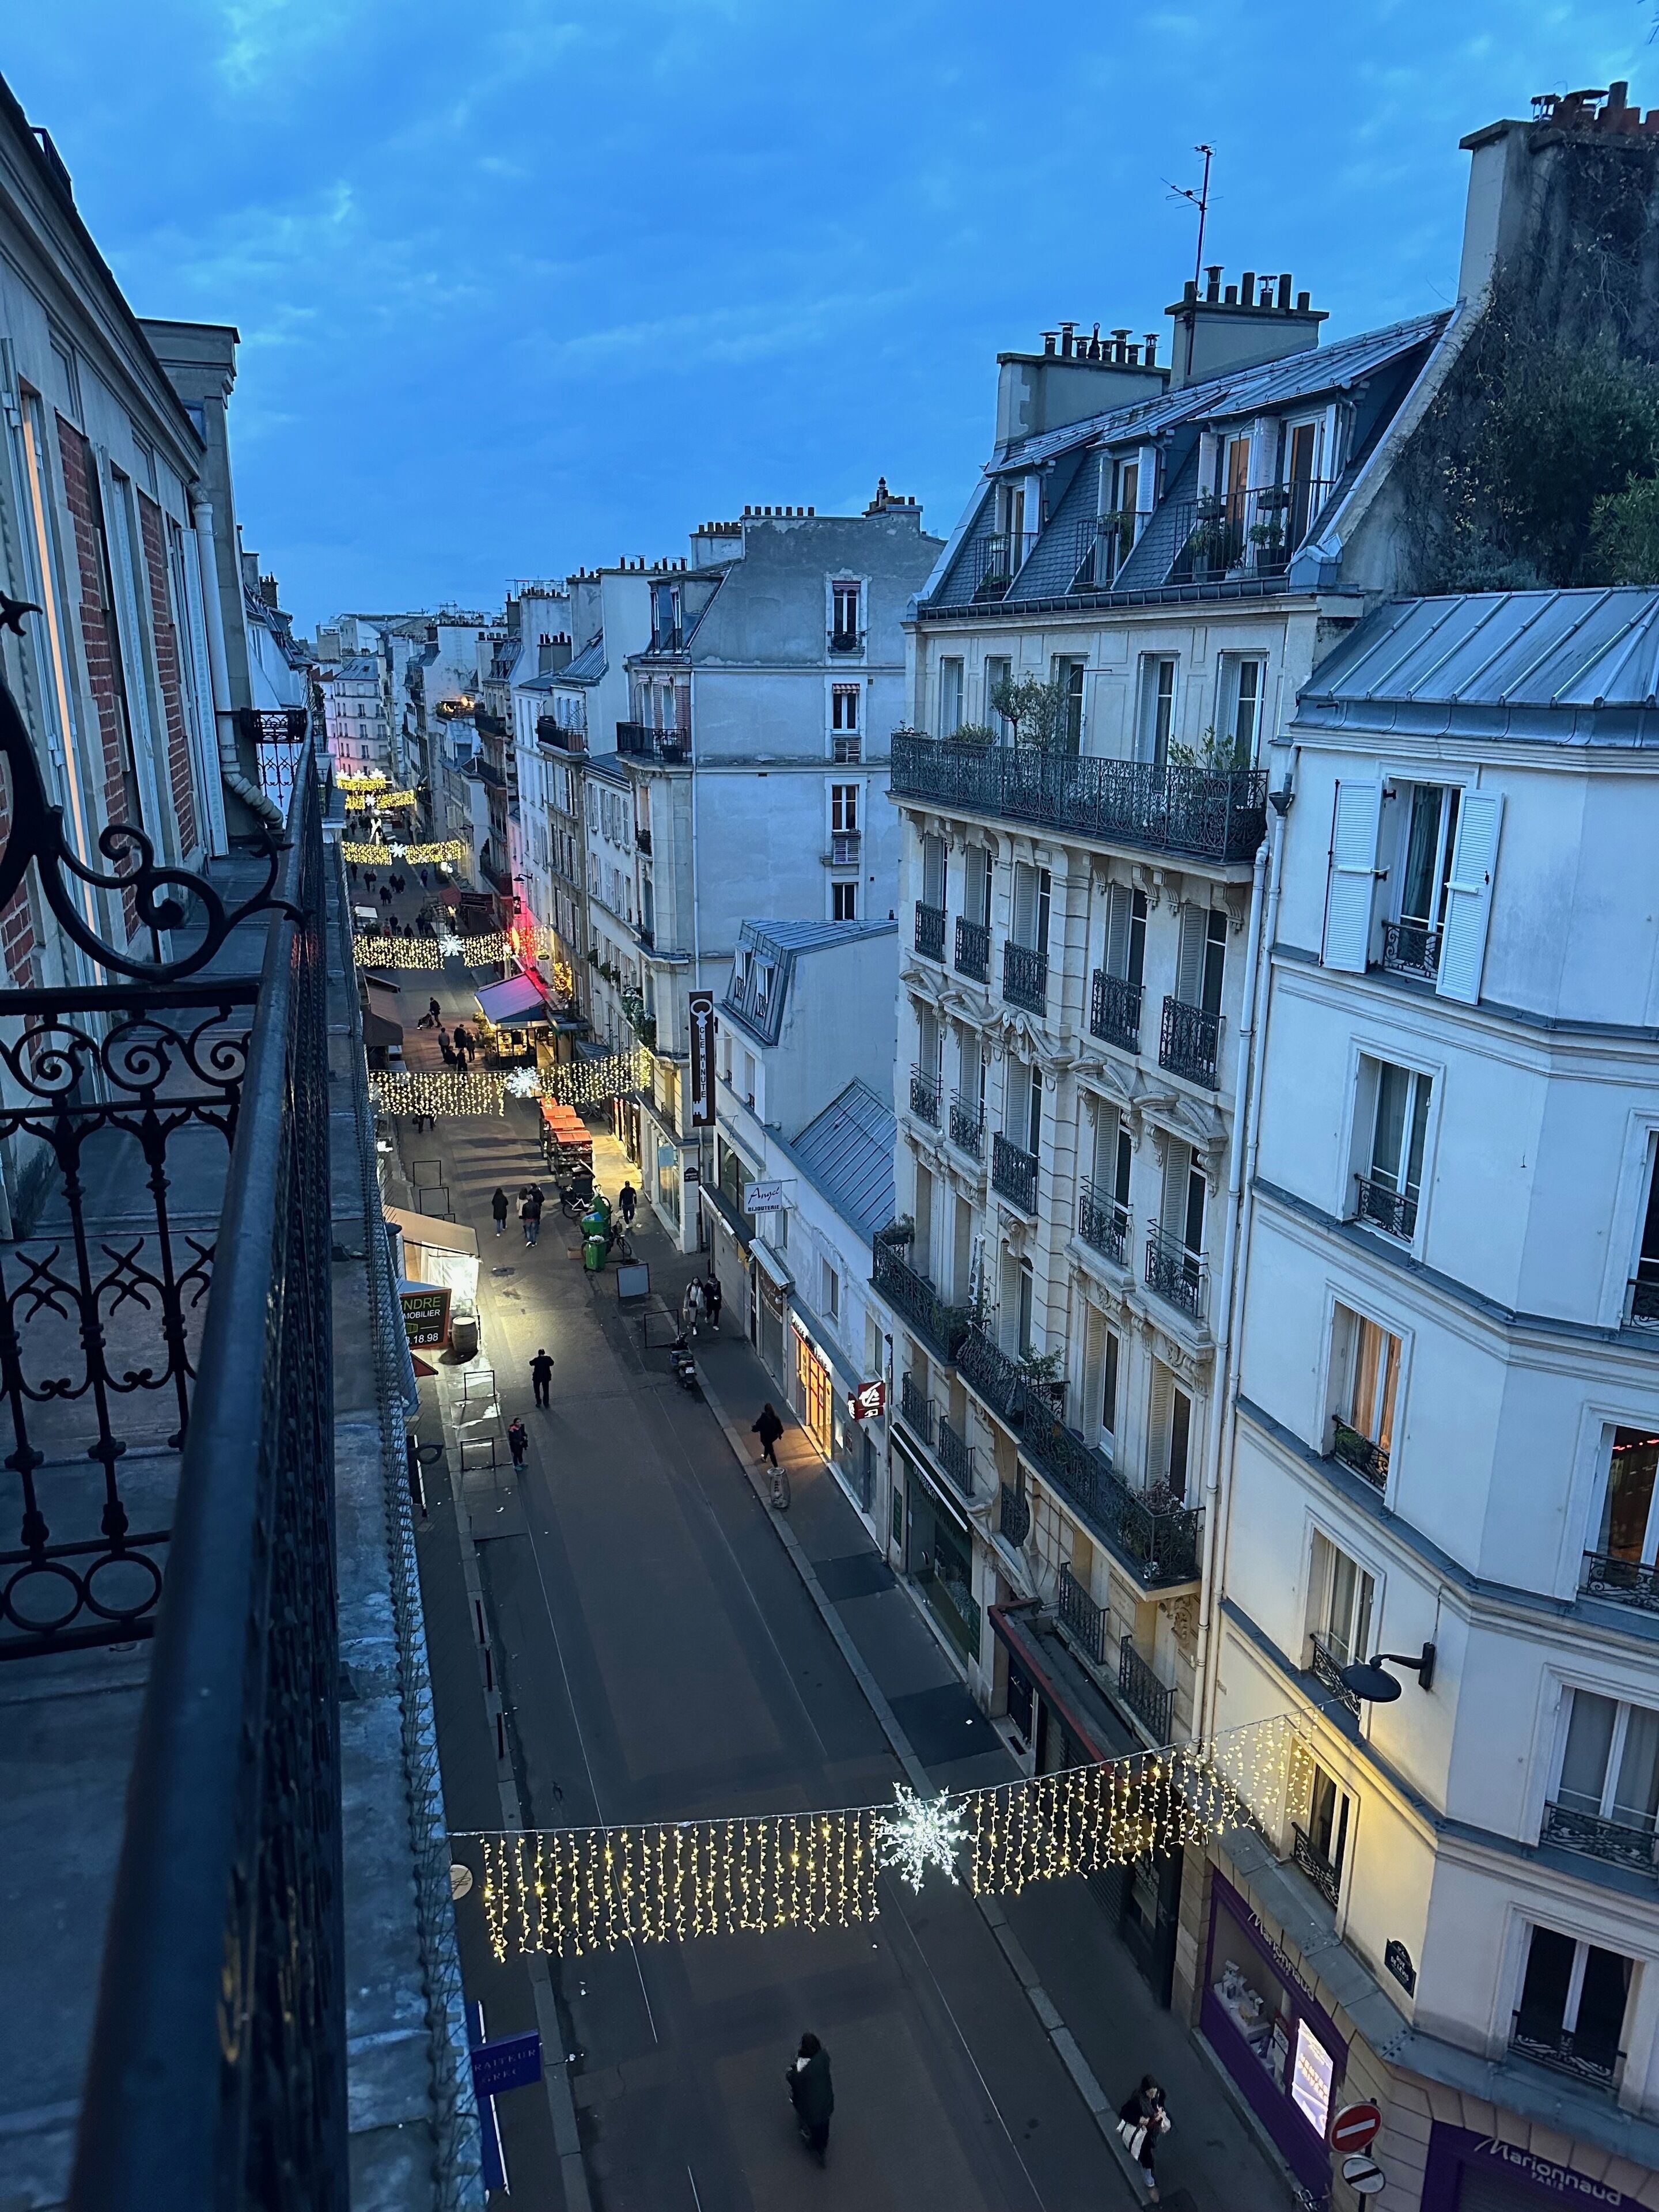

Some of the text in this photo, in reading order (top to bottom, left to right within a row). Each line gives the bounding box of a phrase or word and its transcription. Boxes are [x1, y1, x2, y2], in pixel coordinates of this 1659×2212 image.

[748, 1186, 779, 1205] Angel
[400, 1296, 441, 1310] NDRE
[1248, 1912, 1314, 2002] Marionnaud
[1474, 2137, 1622, 2206] Marionnaud
